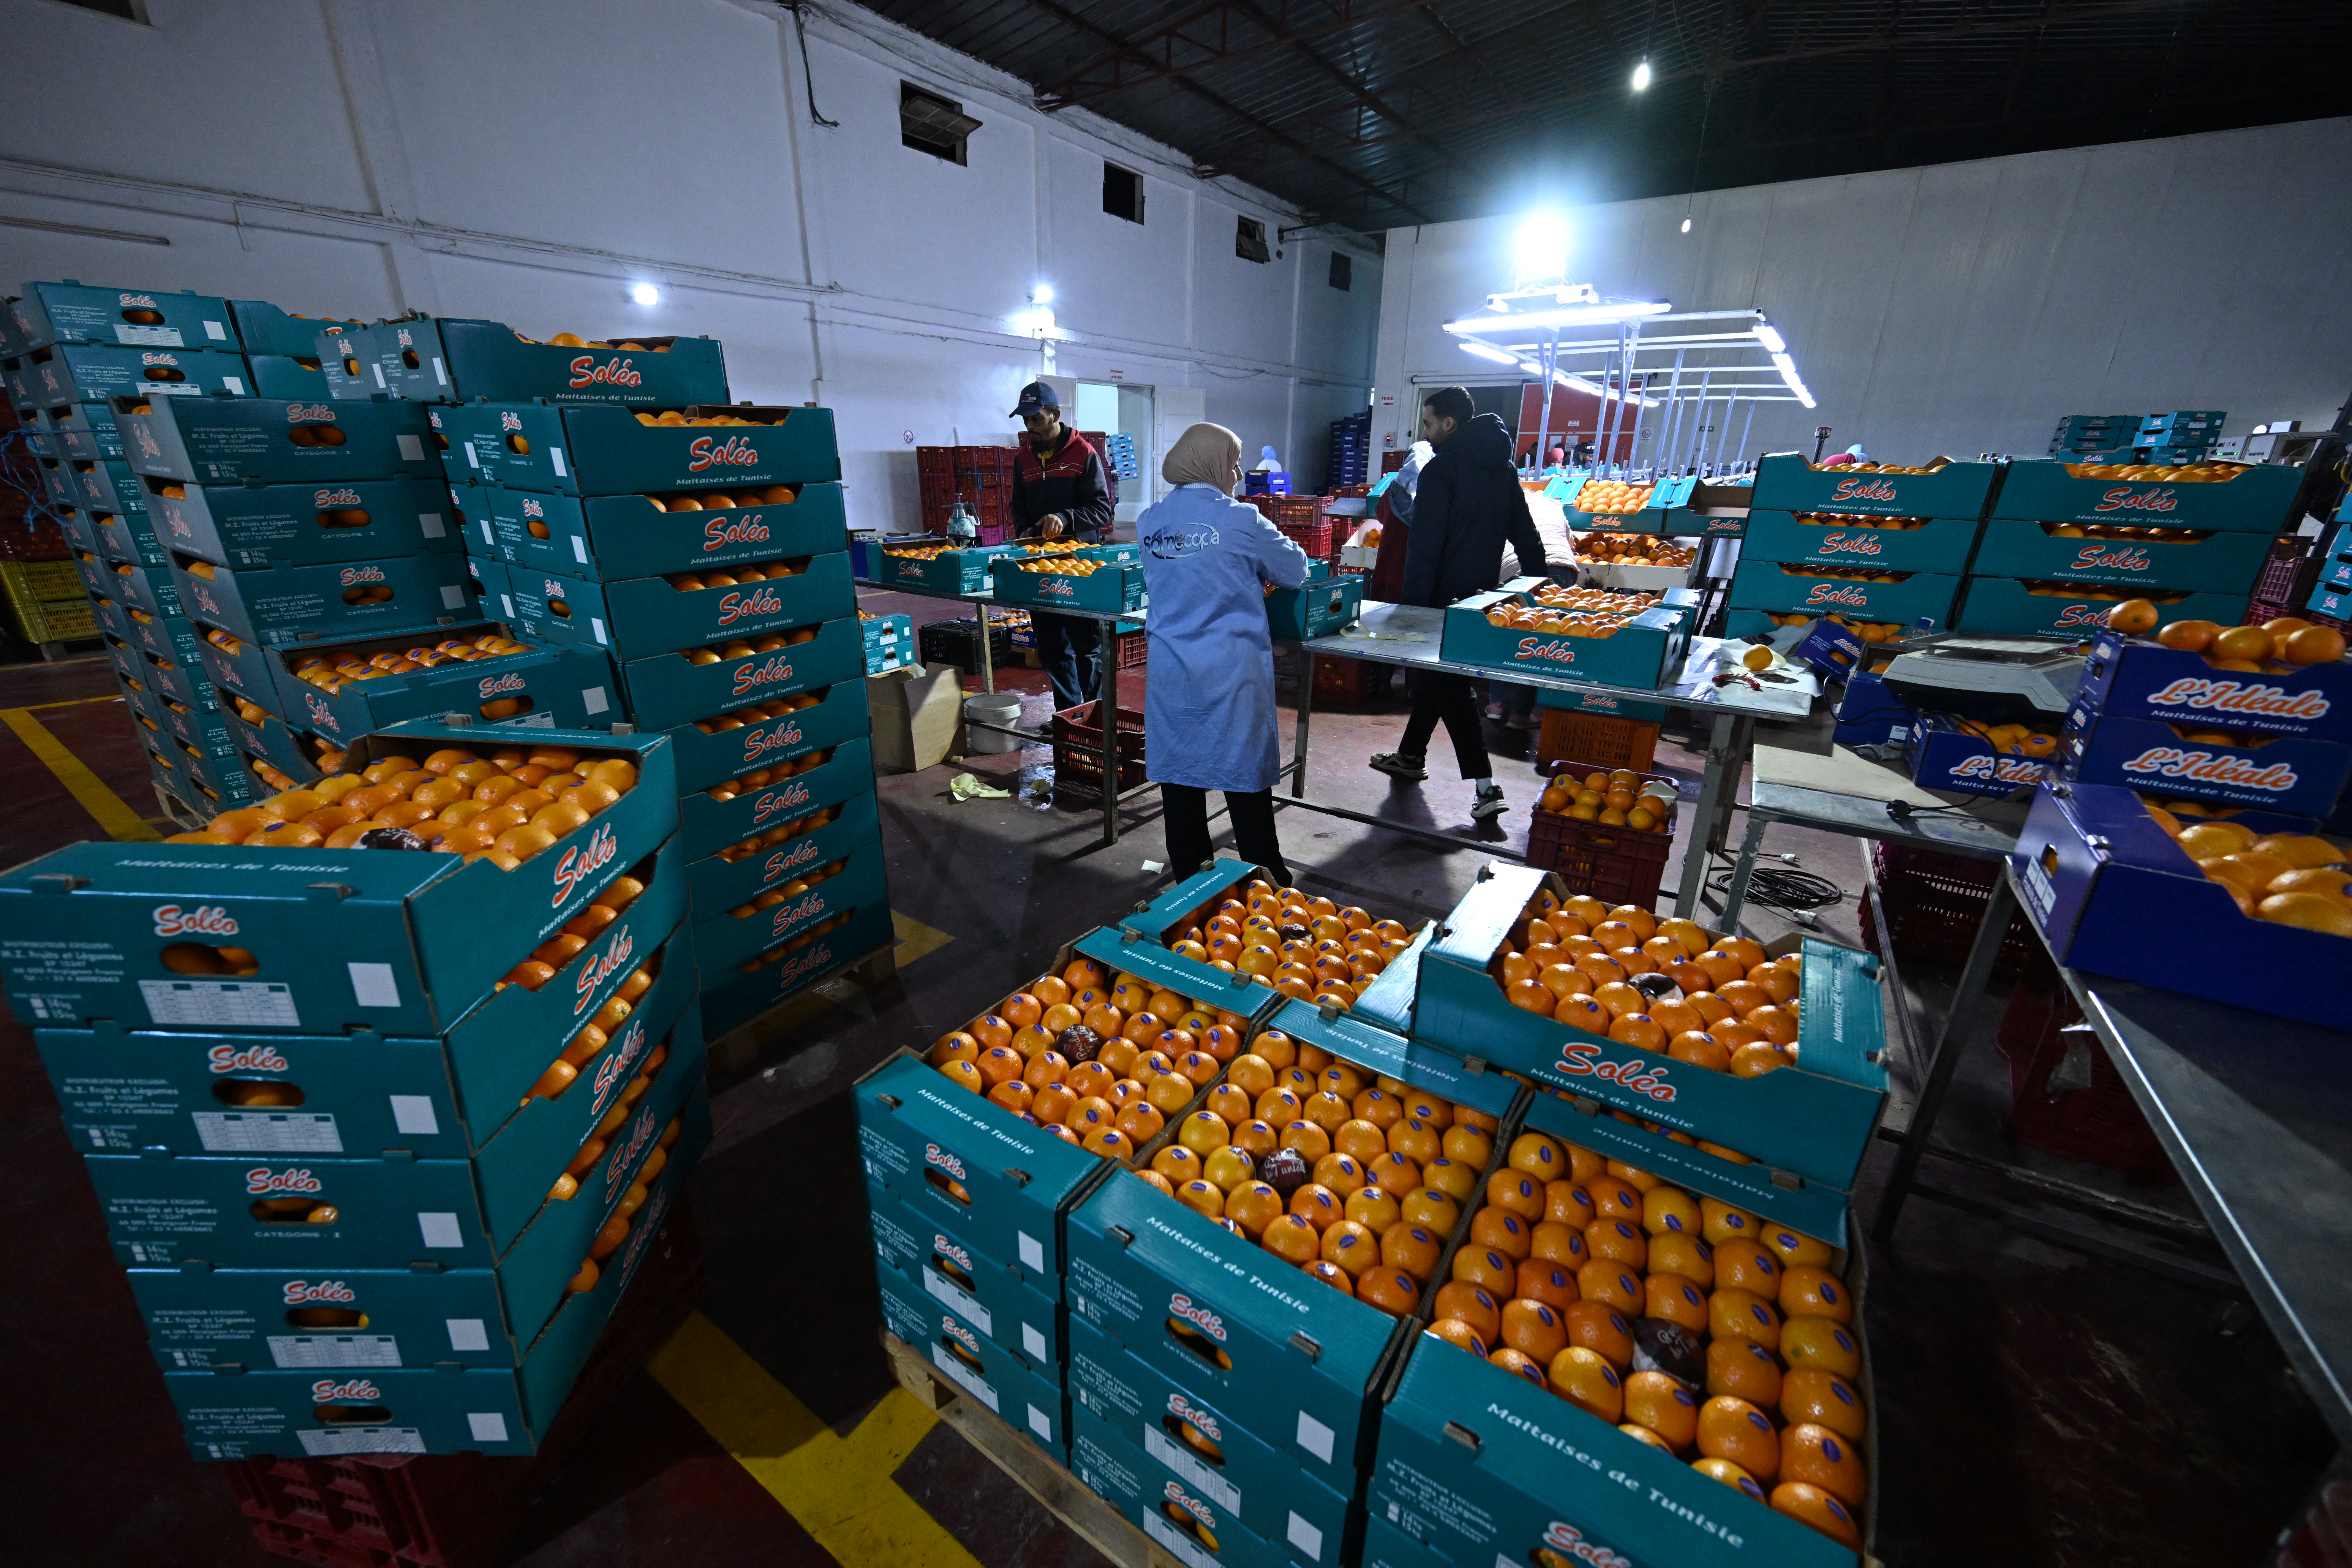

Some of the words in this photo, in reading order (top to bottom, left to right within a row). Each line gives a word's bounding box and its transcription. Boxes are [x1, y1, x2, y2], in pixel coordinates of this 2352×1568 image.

[119, 294, 157, 308] Soléo
[142, 352, 178, 365] Soléo
[569, 355, 642, 388] Soléo
[286, 403, 336, 423] Soléo
[501, 411, 522, 431] Soléo
[689, 436, 758, 472] Soléo
[314, 488, 361, 508] Soléo
[1832, 478, 1896, 501] Soléo
[2094, 487, 2178, 512] Soléo
[523, 498, 544, 517] Soléo
[1591, 515, 1621, 526] Soléo
[703, 514, 770, 551] Soléo
[1707, 519, 1741, 531] Soléo
[1118, 552, 1130, 561] Soléo
[1819, 532, 1881, 555] Soléo
[691, 555, 736, 564] Maltaises
[899, 561, 924, 577] Soléo
[988, 554, 1001, 563] Solé
[2071, 545, 2150, 571] Soléo
[340, 566, 385, 586] Soléo
[544, 579, 565, 598] Soléo
[1038, 577, 1073, 597] Soléo
[718, 587, 782, 626] Soléo
[1331, 589, 1342, 601] Soléo
[1805, 584, 1867, 607] Soléo
[706, 628, 750, 639] Maltaises
[765, 618, 793, 628] Tunisie
[2054, 605, 2113, 628] Sol
[1515, 637, 1574, 663] Soléo
[732, 656, 793, 695] Soléo
[1502, 661, 1540, 670] Maltaises
[479, 673, 525, 699] Soléo
[721, 695, 762, 709] Maltaises
[777, 683, 804, 694] Tunisie
[2147, 677, 2330, 721] L'Idéale
[305, 693, 340, 735] Soléo
[1581, 694, 1617, 709] Soléo
[2151, 710, 2224, 723] Maltaises
[2252, 721, 2308, 732] Tunisie
[744, 721, 802, 761] Soléo
[733, 760, 773, 775] Maltaises
[787, 746, 813, 757] Tunisie
[2122, 747, 2298, 792] L'Idéale
[753, 782, 809, 824] Soléo
[2126, 777, 2195, 791] Maltaises
[2223, 791, 2277, 803] Tunisie
[115, 860, 229, 869] Maltaises
[270, 864, 349, 873] Tunisie
[552, 823, 616, 910] Soléo
[763, 840, 818, 882] Soléo
[539, 896, 584, 938] Maltaises
[586, 886, 597, 898] de
[600, 860, 626, 887] Tunisie
[153, 904, 239, 937] Soléo
[773, 893, 825, 936] Soléo
[574, 925, 632, 1015] Soléo
[781, 943, 831, 988] Soléo
[1122, 950, 1157, 965] Tunisie
[1174, 968, 1224, 990] Maltaises
[208, 1045, 288, 1073] Soléo
[591, 1020, 644, 1115] Soléo
[1554, 1042, 1677, 1103] Soléo
[1531, 1069, 1605, 1099] Maltaises
[1609, 1097, 1629, 1106] de
[1636, 1105, 1694, 1128] Tunisie
[918, 1089, 973, 1121] Maltaises
[973, 1121, 989, 1130] de
[991, 1129, 1034, 1155] Tunisie
[605, 1105, 654, 1204] Soléo
[925, 1143, 966, 1180] Soléo
[246, 1168, 322, 1194] Soléo
[926, 1189, 961, 1214] CATEGORIE
[934, 1234, 972, 1273] Soléo
[1146, 1217, 1221, 1263] Maltaises
[1223, 1263, 1245, 1277] de
[1249, 1275, 1309, 1313] Tunisie
[283, 1280, 355, 1304] Soléo
[1169, 1293, 1227, 1341] Soléo
[942, 1316, 979, 1352] Soléo
[1163, 1341, 1212, 1376] CATEGORIE
[312, 1379, 380, 1402] Soléo
[1167, 1393, 1221, 1441] Soléo
[1487, 1403, 1601, 1470] Maltaises
[1608, 1469, 1640, 1491] de
[1649, 1487, 1743, 1547] Tunisie
[1164, 1481, 1216, 1528] Soléo
